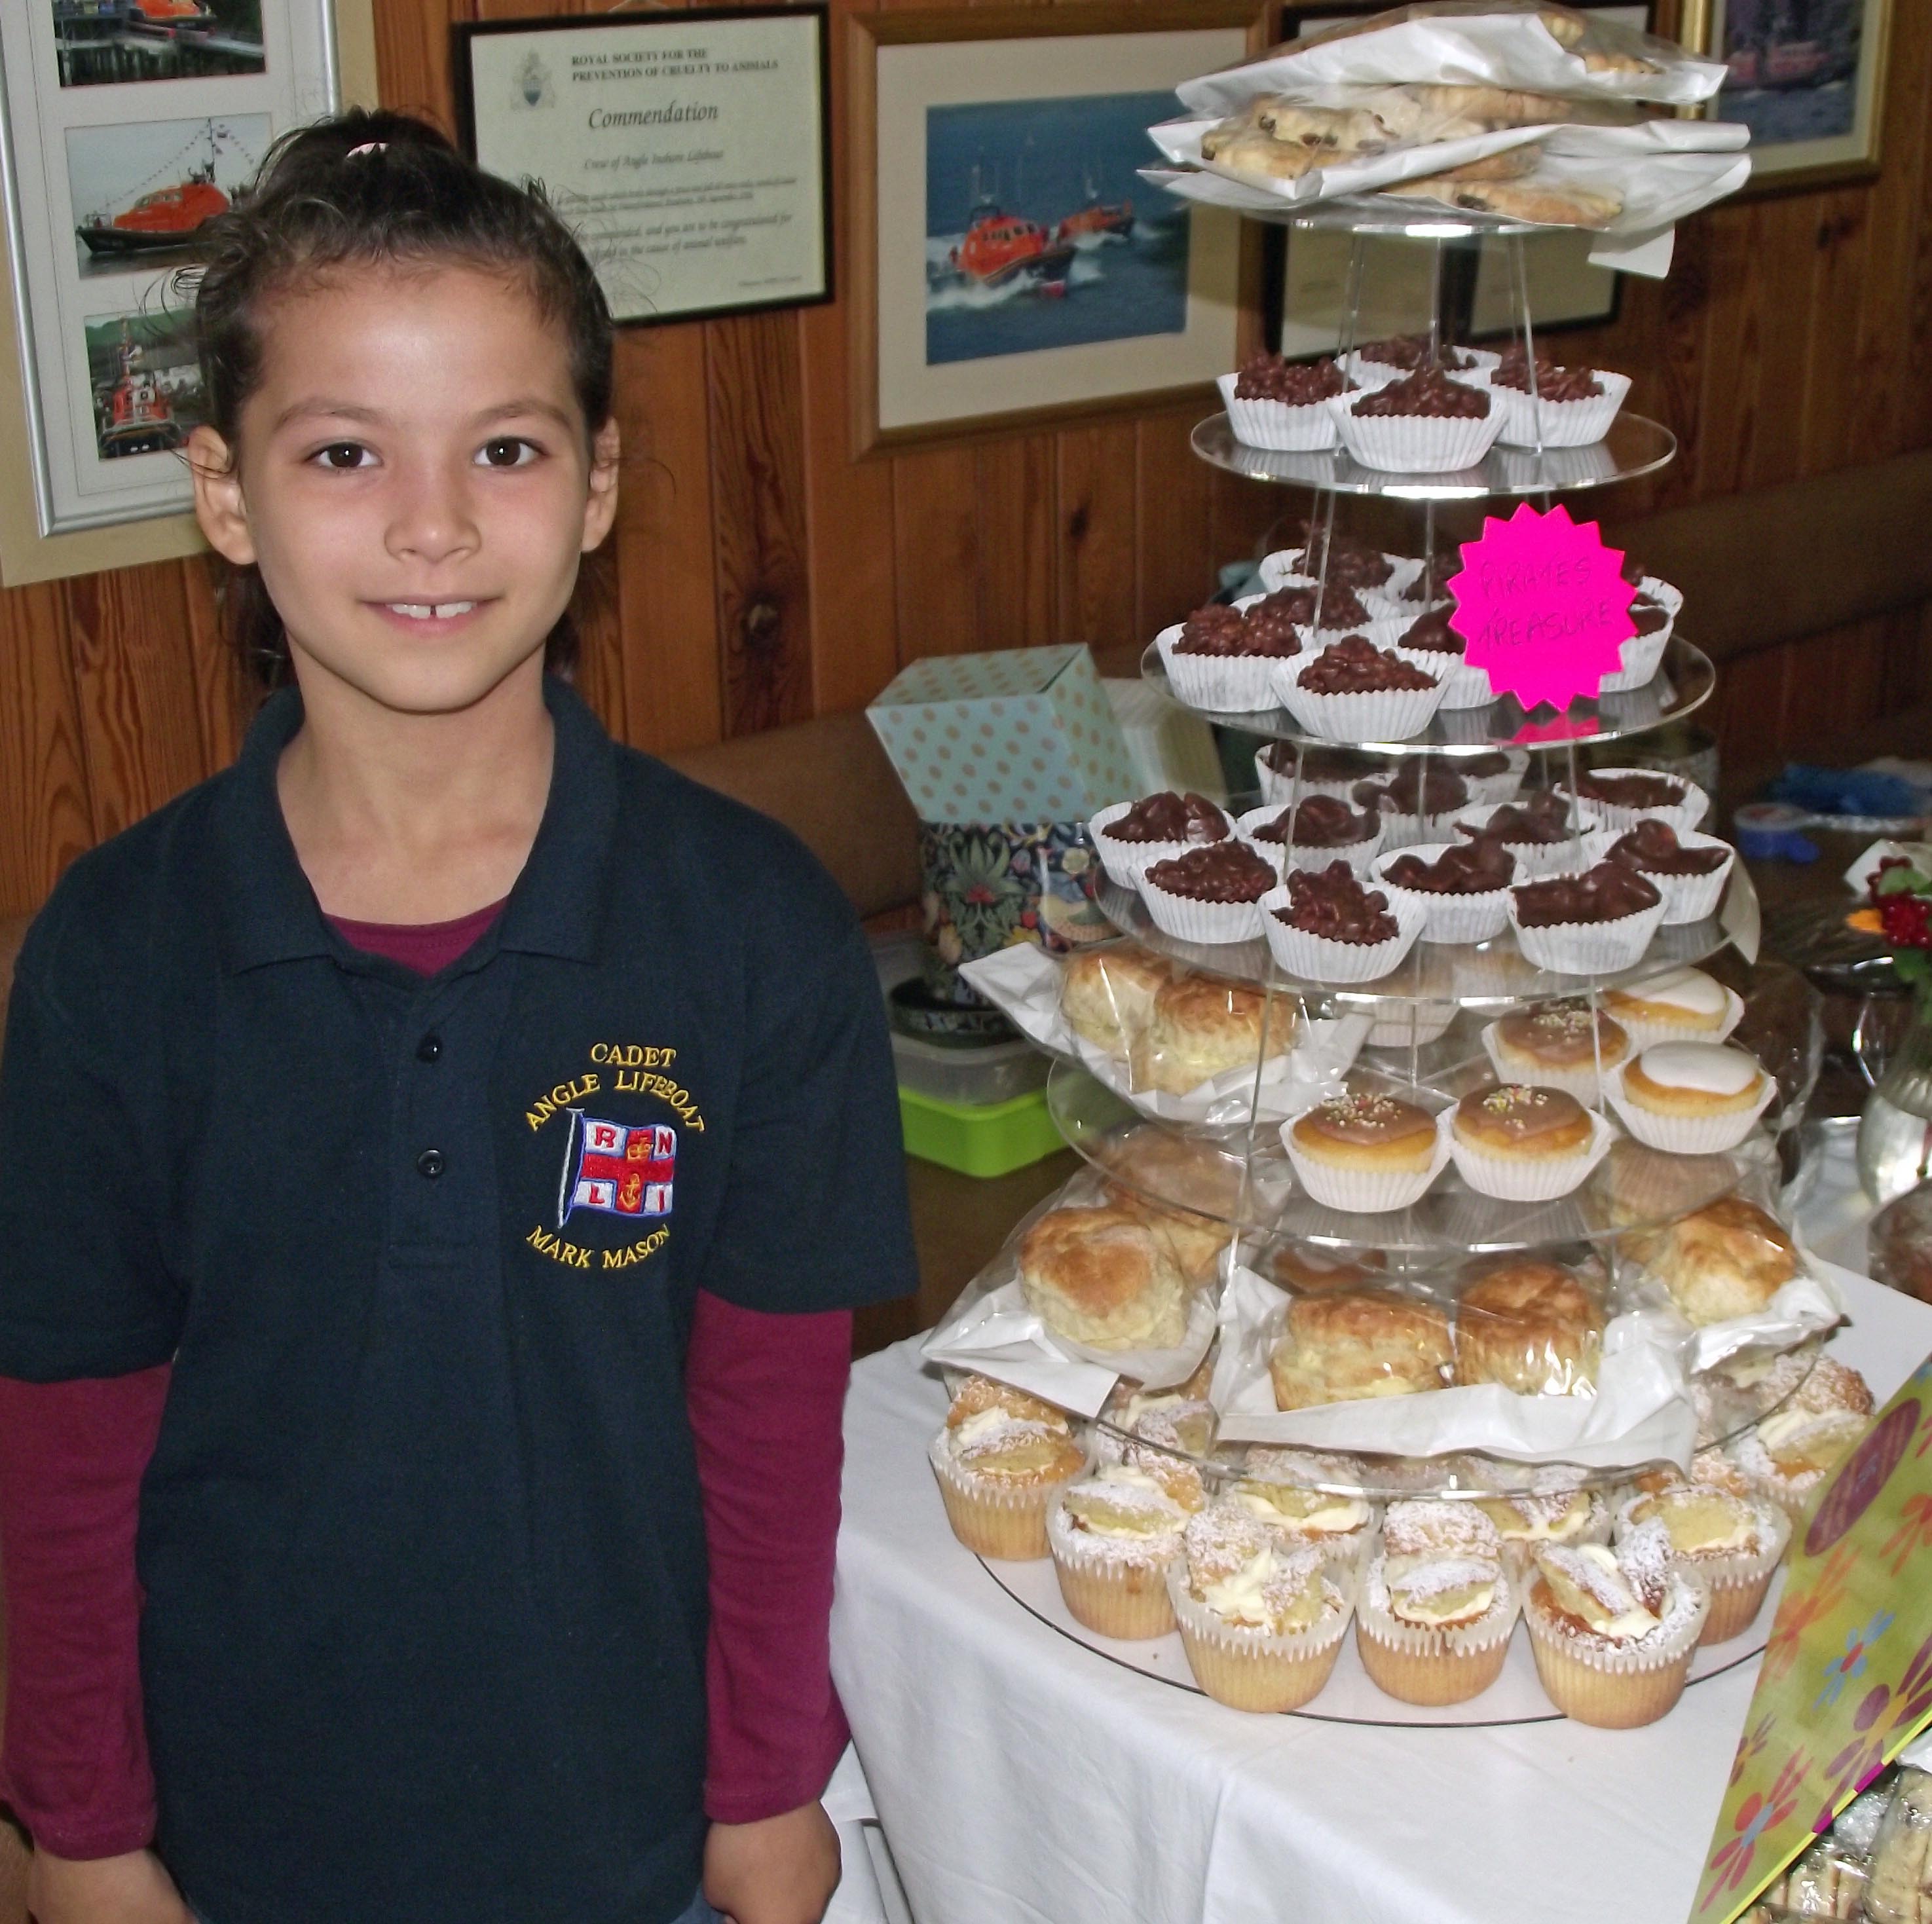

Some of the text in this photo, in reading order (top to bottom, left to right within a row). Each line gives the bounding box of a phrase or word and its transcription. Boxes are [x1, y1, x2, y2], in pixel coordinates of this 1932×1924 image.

[572, 48, 707, 65] ROYAL SOCIETY FOR THE
[572, 58, 779, 81] PREVENTION OF CRUELTY TO ANIMALS
[588, 99, 718, 129] Commendation
[611, 155, 621, 172] of
[623, 153, 648, 169] Angle
[1480, 550, 1592, 599] PIRATES
[1477, 597, 1612, 651] TREASURE
[591, 1043, 677, 1067] CADET
[526, 1069, 705, 1133] ANGLE LIFEBOAT
[525, 1223, 671, 1269] MARK MASON
